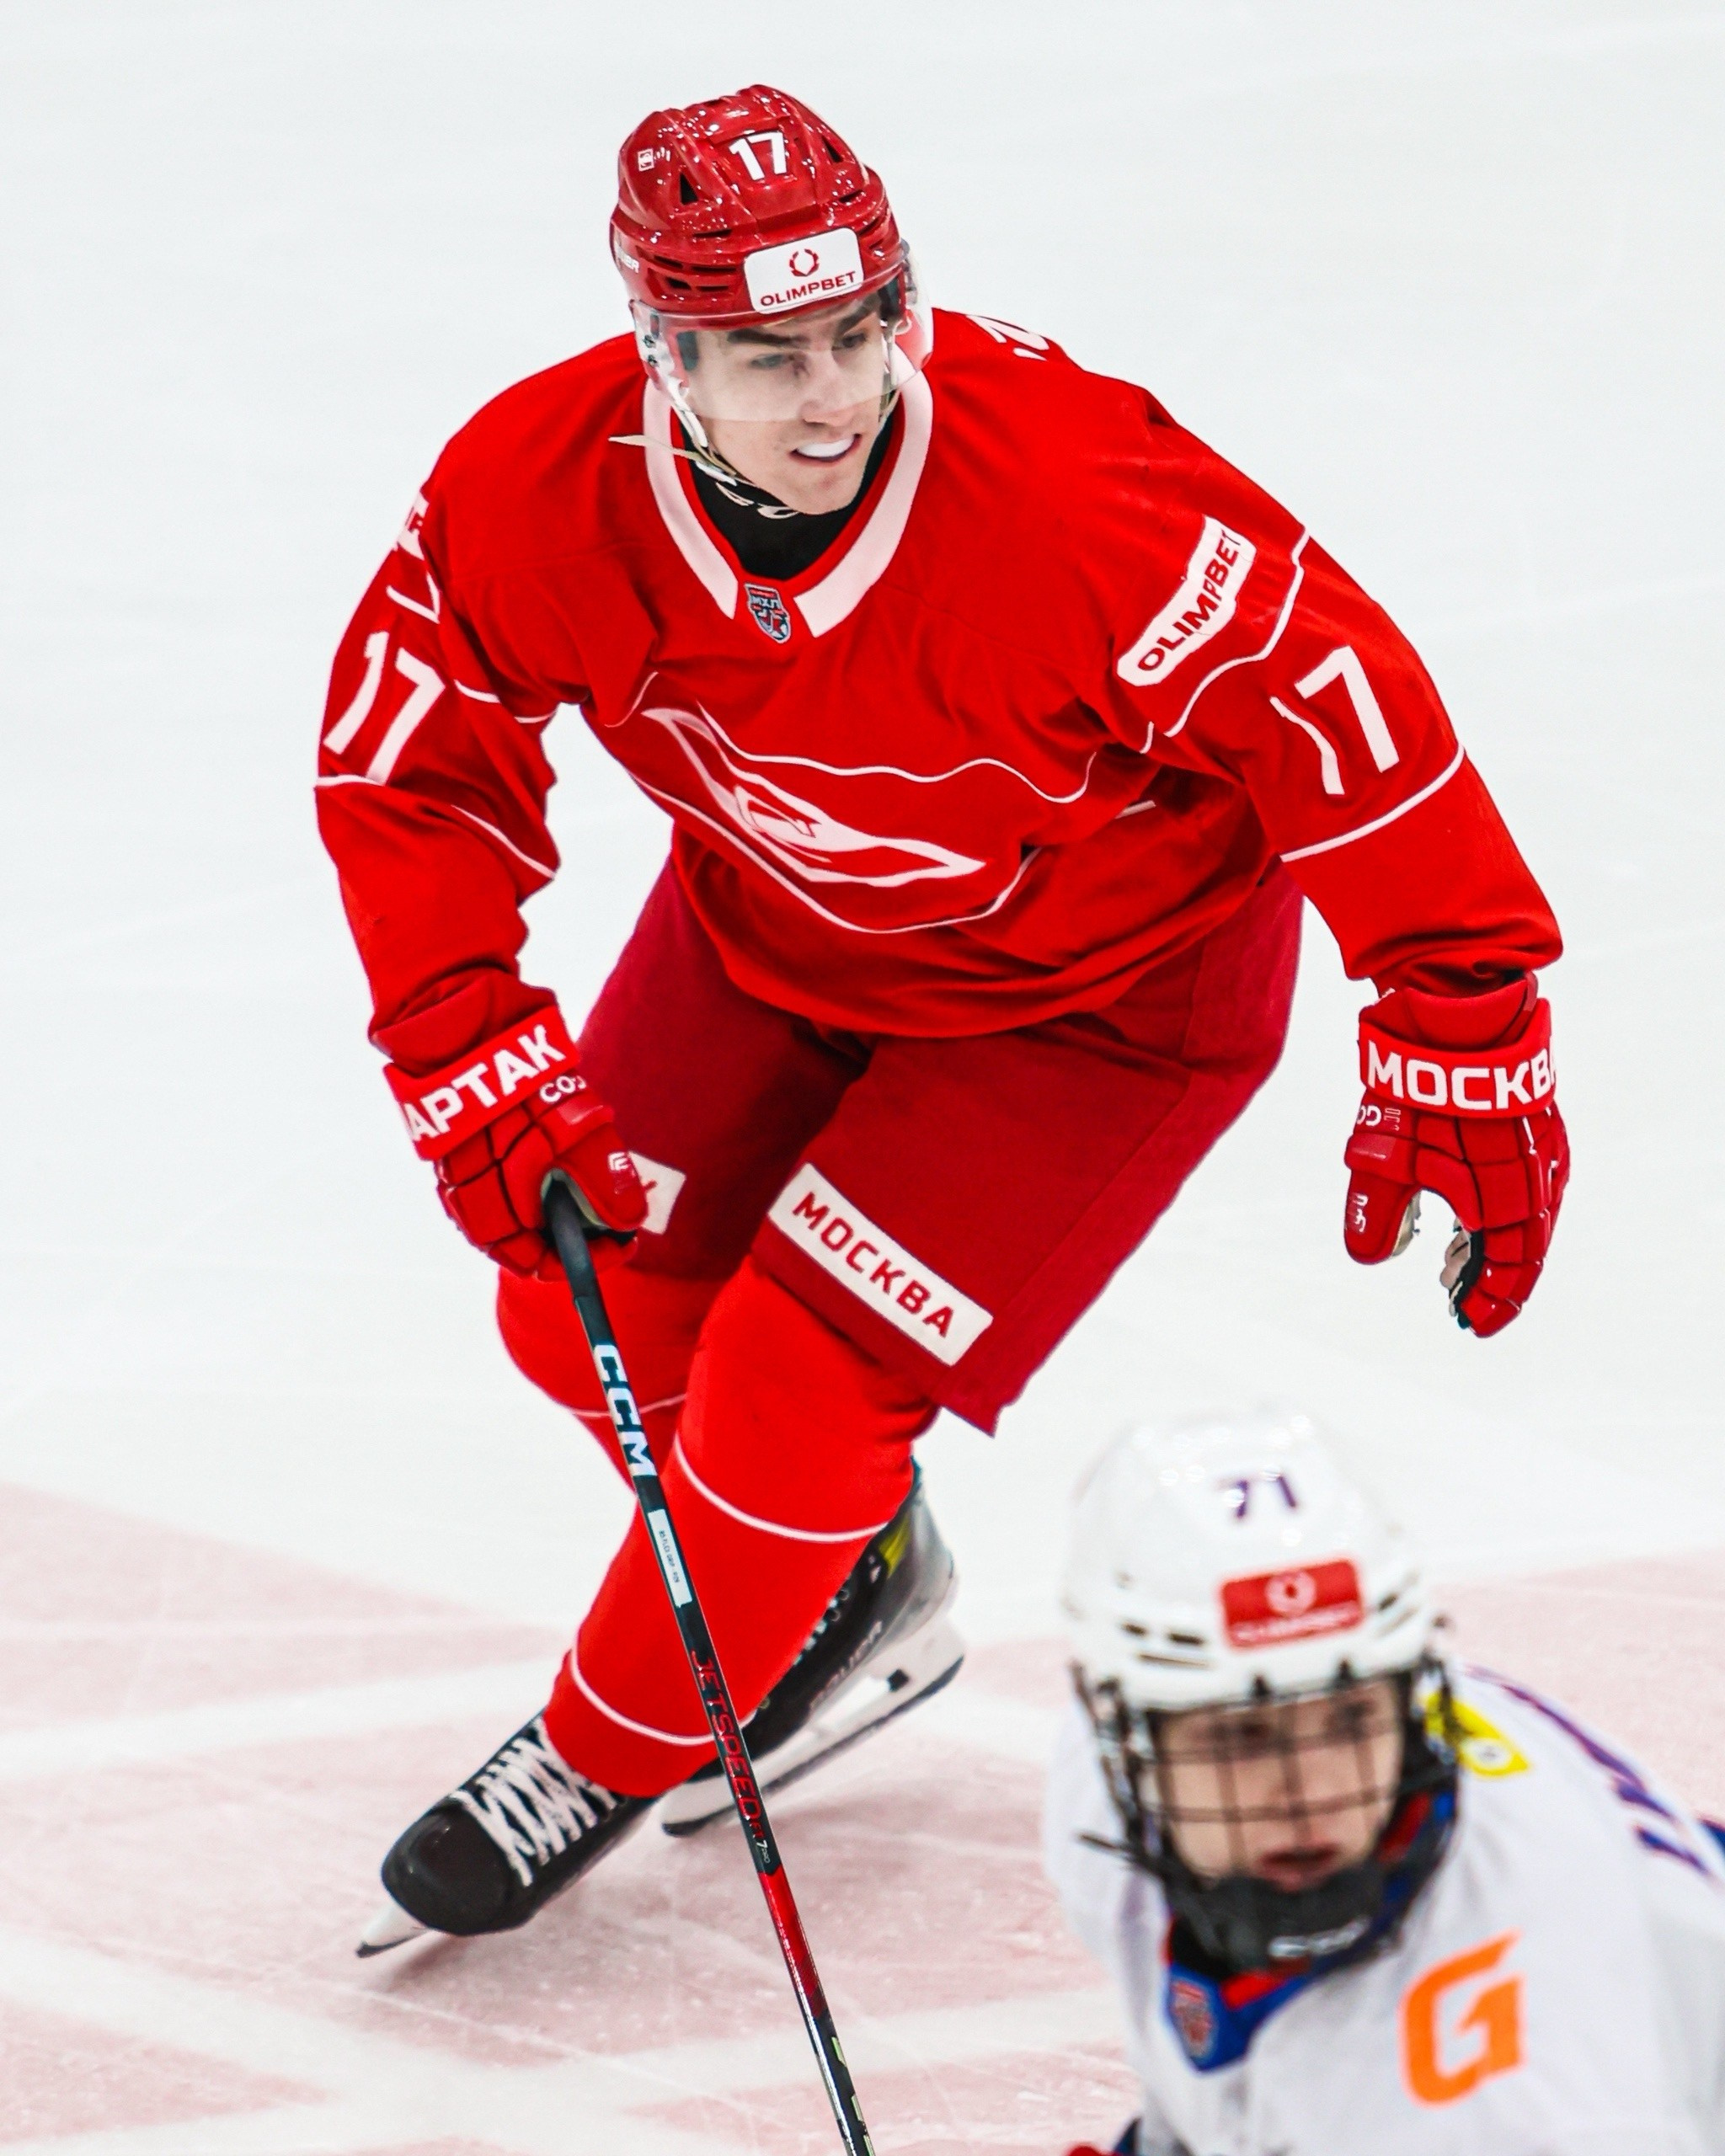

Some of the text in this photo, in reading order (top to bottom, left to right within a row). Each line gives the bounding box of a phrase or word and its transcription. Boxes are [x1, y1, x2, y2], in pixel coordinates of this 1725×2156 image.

[729, 131, 788, 181] 17
[760, 270, 857, 307] OLIMPBET
[323, 630, 446, 786] 17
[1269, 644, 1400, 796] 17
[1367, 1035, 1557, 1111] МОСКВ
[792, 1191, 954, 1338] МОСКВА
[593, 1344, 658, 1476] CCM
[691, 1649, 763, 1821] JETSPEED
